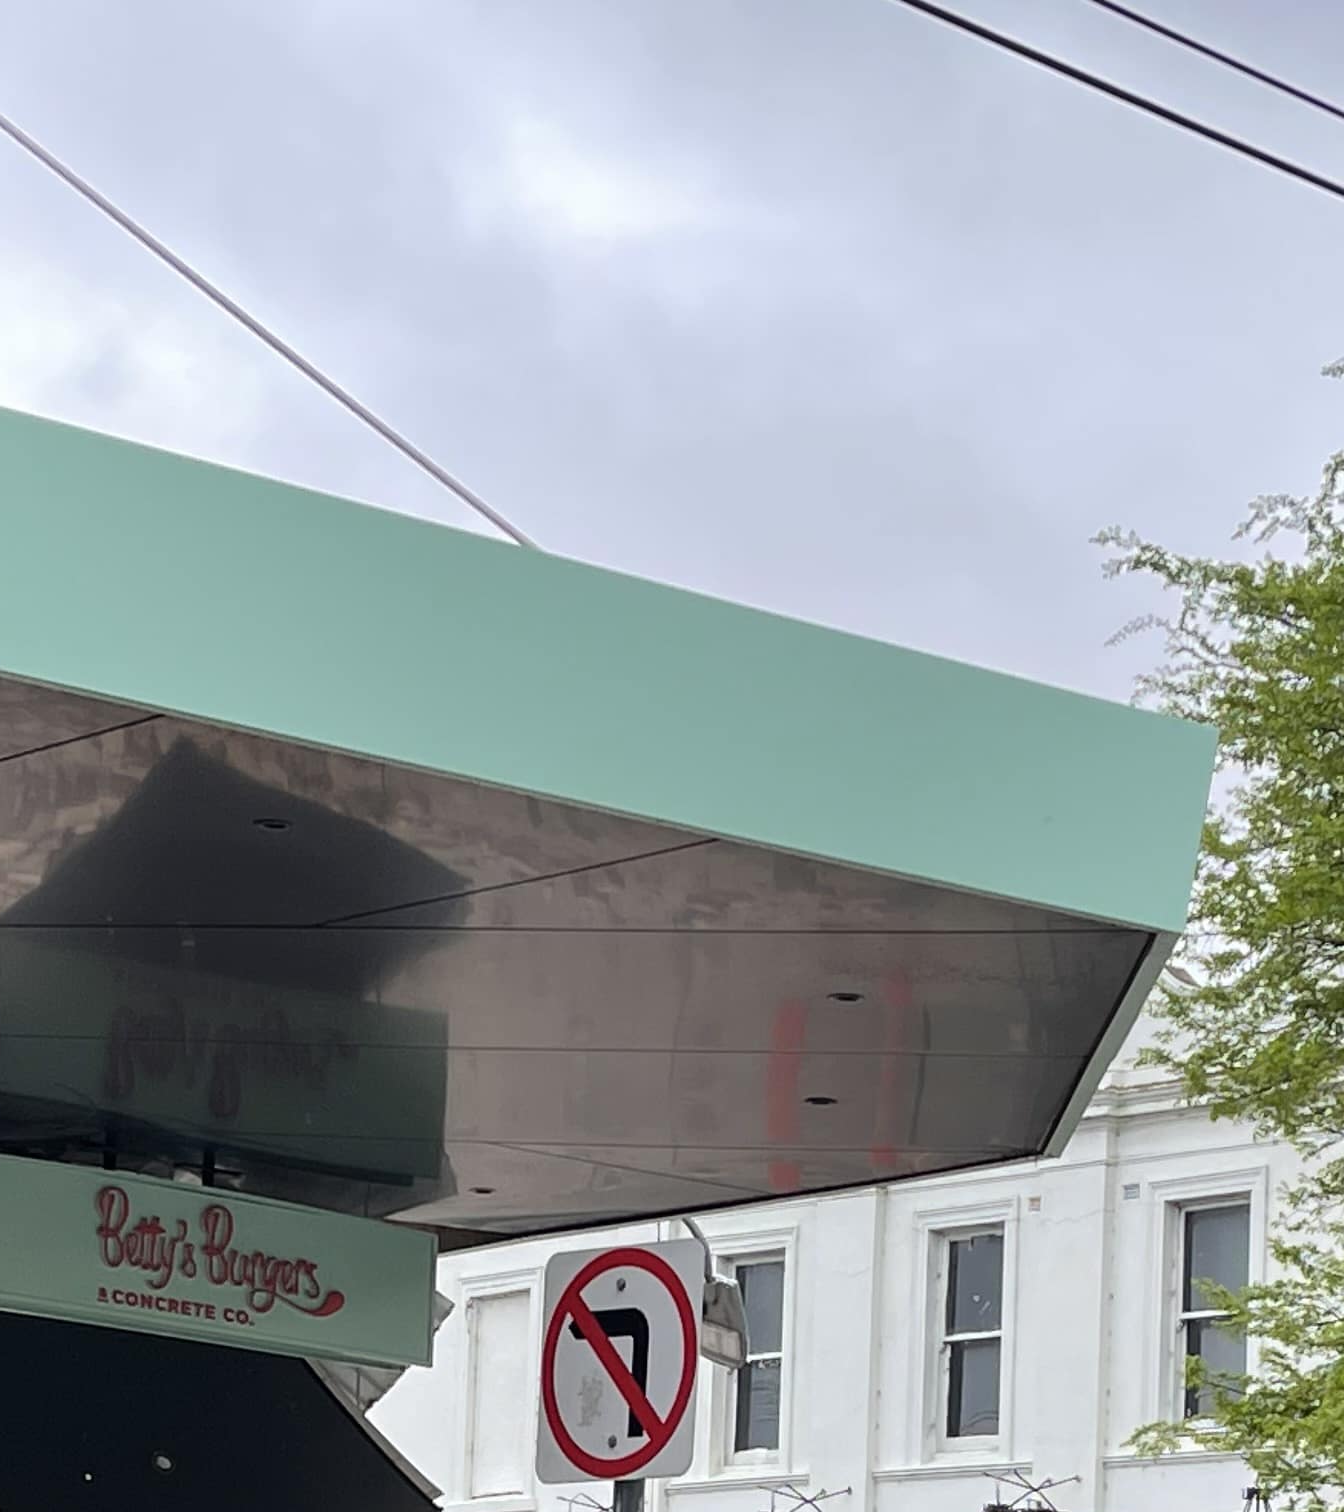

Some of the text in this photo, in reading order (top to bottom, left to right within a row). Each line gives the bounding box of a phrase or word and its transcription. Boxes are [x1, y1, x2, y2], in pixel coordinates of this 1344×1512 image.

[96, 1185, 345, 1317] Betty's Burgers
[112, 1289, 216, 1320] CONCRETE
[223, 1307, 255, 1326] CO.
